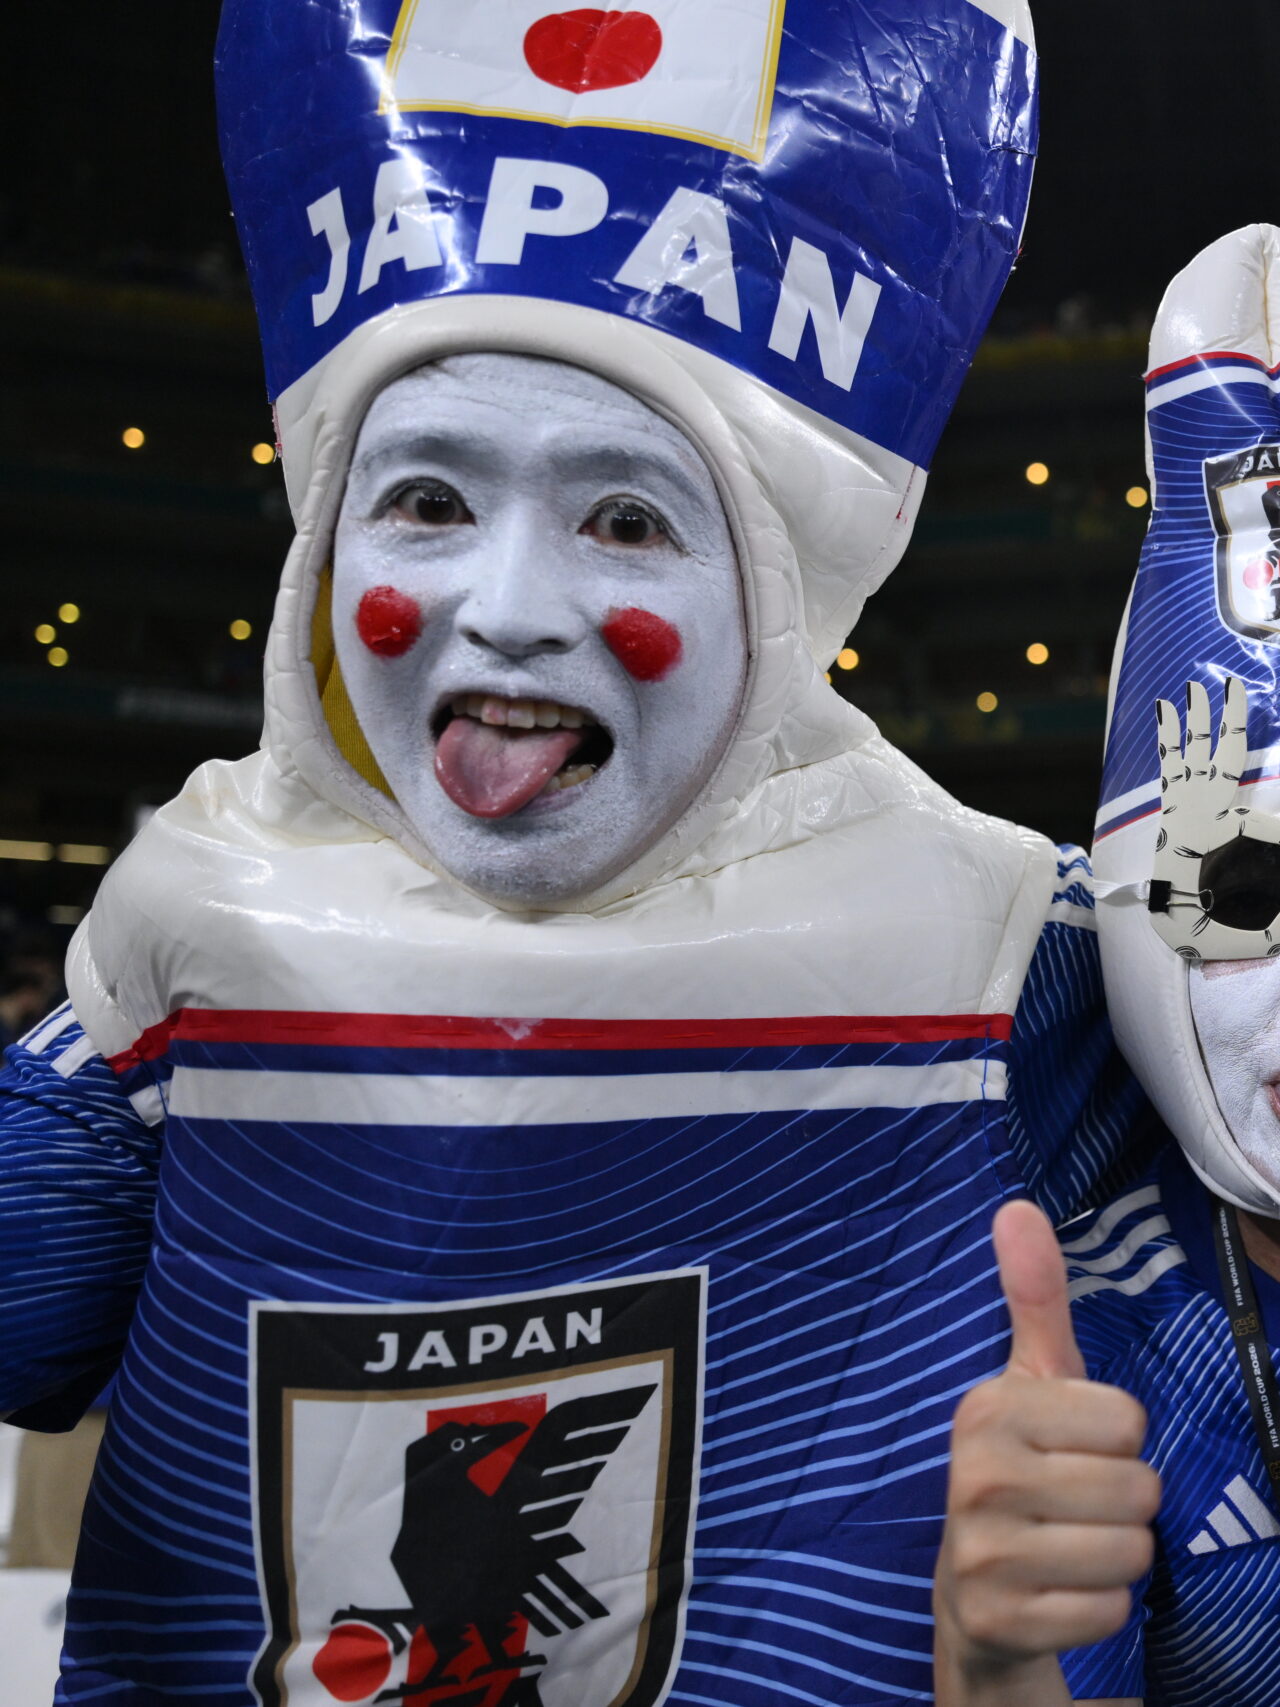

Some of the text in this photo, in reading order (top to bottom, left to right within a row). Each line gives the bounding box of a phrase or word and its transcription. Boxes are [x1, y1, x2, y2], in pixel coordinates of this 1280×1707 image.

[305, 156, 882, 392] JAPAN
[1224, 1239, 1233, 1255] CUP
[1228, 1256, 1239, 1287] WORLD
[1234, 1287, 1244, 1306] FIFA
[363, 1308, 603, 1373] JAPAN
[1255, 1378, 1266, 1394] CUP
[1261, 1395, 1275, 1427] WORLD
[1269, 1428, 1280, 1448] FIFA
